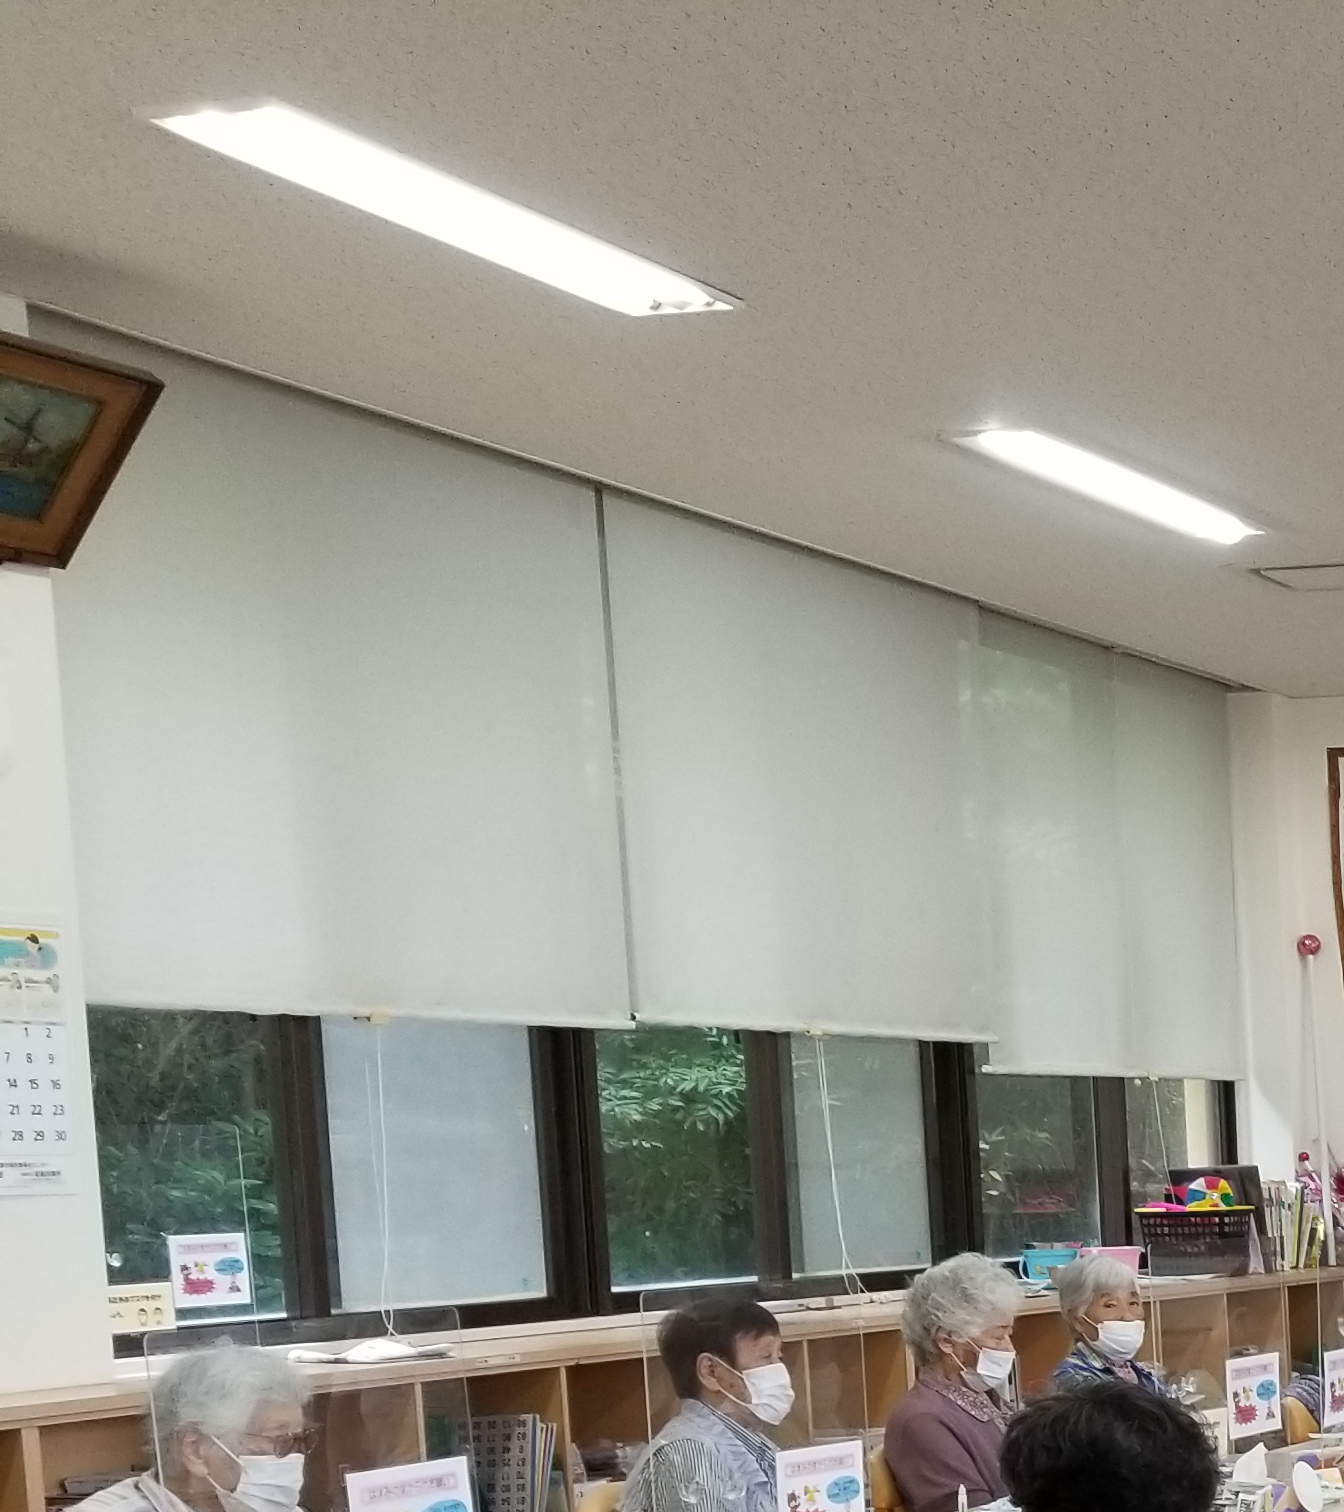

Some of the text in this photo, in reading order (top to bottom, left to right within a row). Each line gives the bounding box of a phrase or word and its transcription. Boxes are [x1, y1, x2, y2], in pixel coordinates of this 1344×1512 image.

[24, 1027, 52, 1039] 1 2
[4, 1052, 54, 1064] 7 8 9
[7, 1078, 61, 1090] 14 15 16
[9, 1104, 65, 1116] 21 22 23
[11, 1130, 67, 1141] 28 29 30
